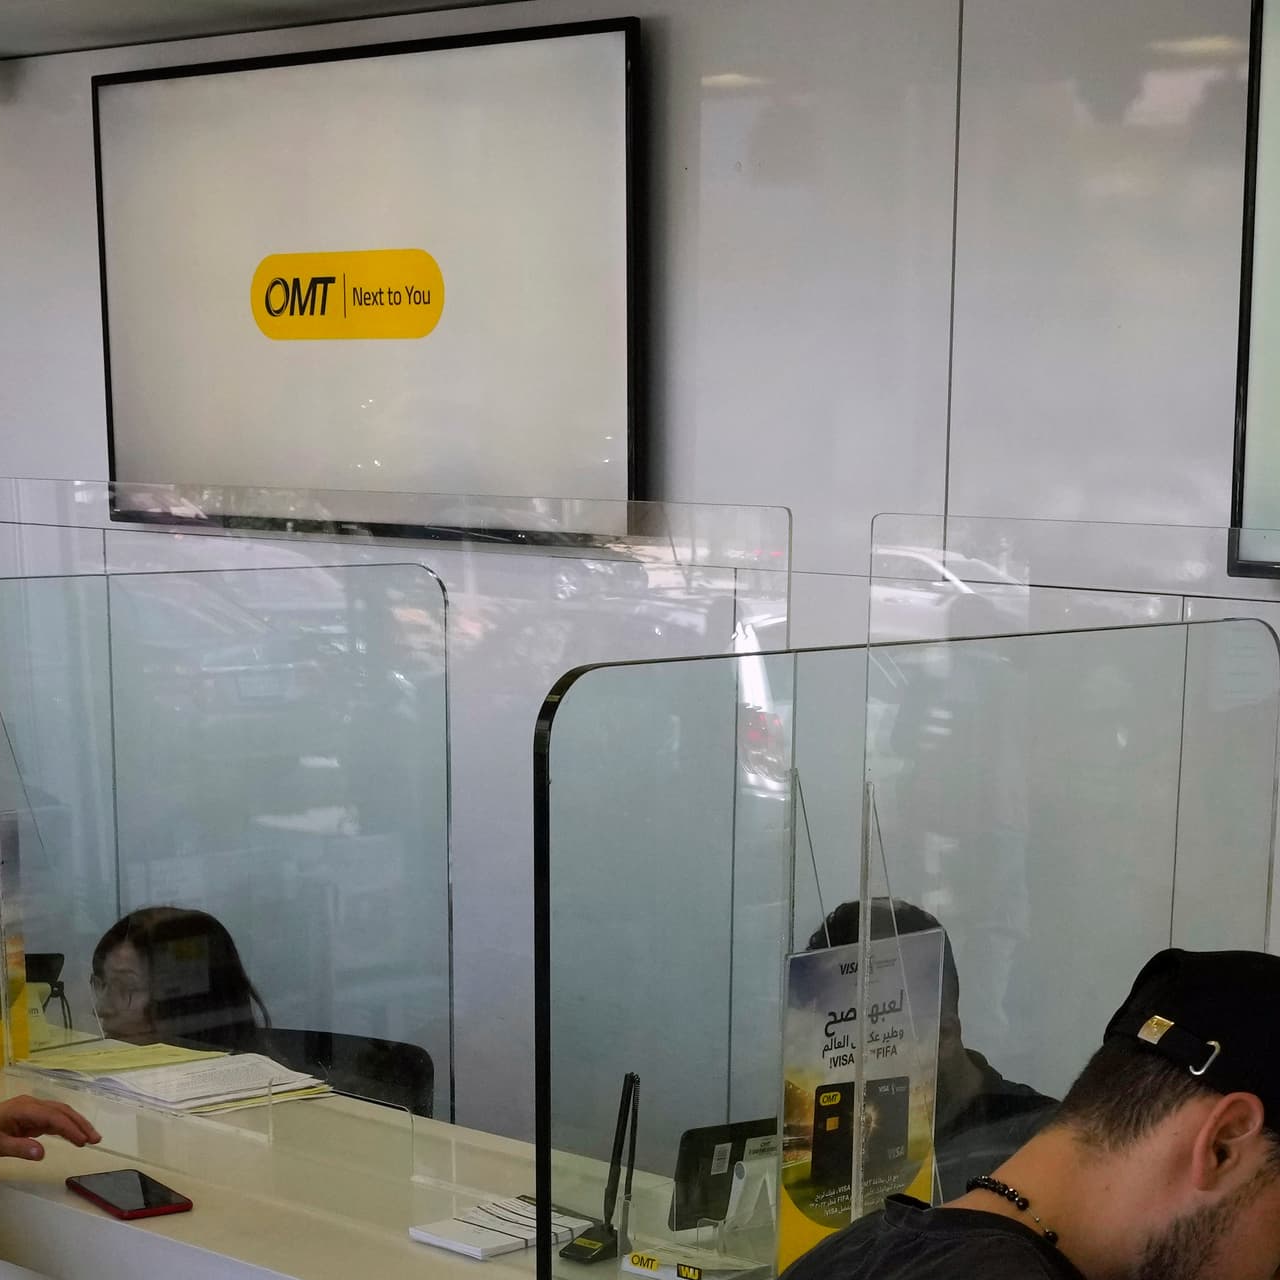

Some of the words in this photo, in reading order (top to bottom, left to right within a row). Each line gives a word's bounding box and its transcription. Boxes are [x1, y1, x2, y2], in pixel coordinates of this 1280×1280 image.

[265, 276, 336, 317] OMT
[352, 286, 385, 306] Next
[387, 289, 402, 306] to
[405, 285, 431, 305] You
[868, 989, 904, 1024] لعبه
[824, 1007, 857, 1037] صح
[822, 1034, 849, 1059] العالم
[822, 1093, 839, 1104] OMT
[631, 1254, 656, 1270] OMT
